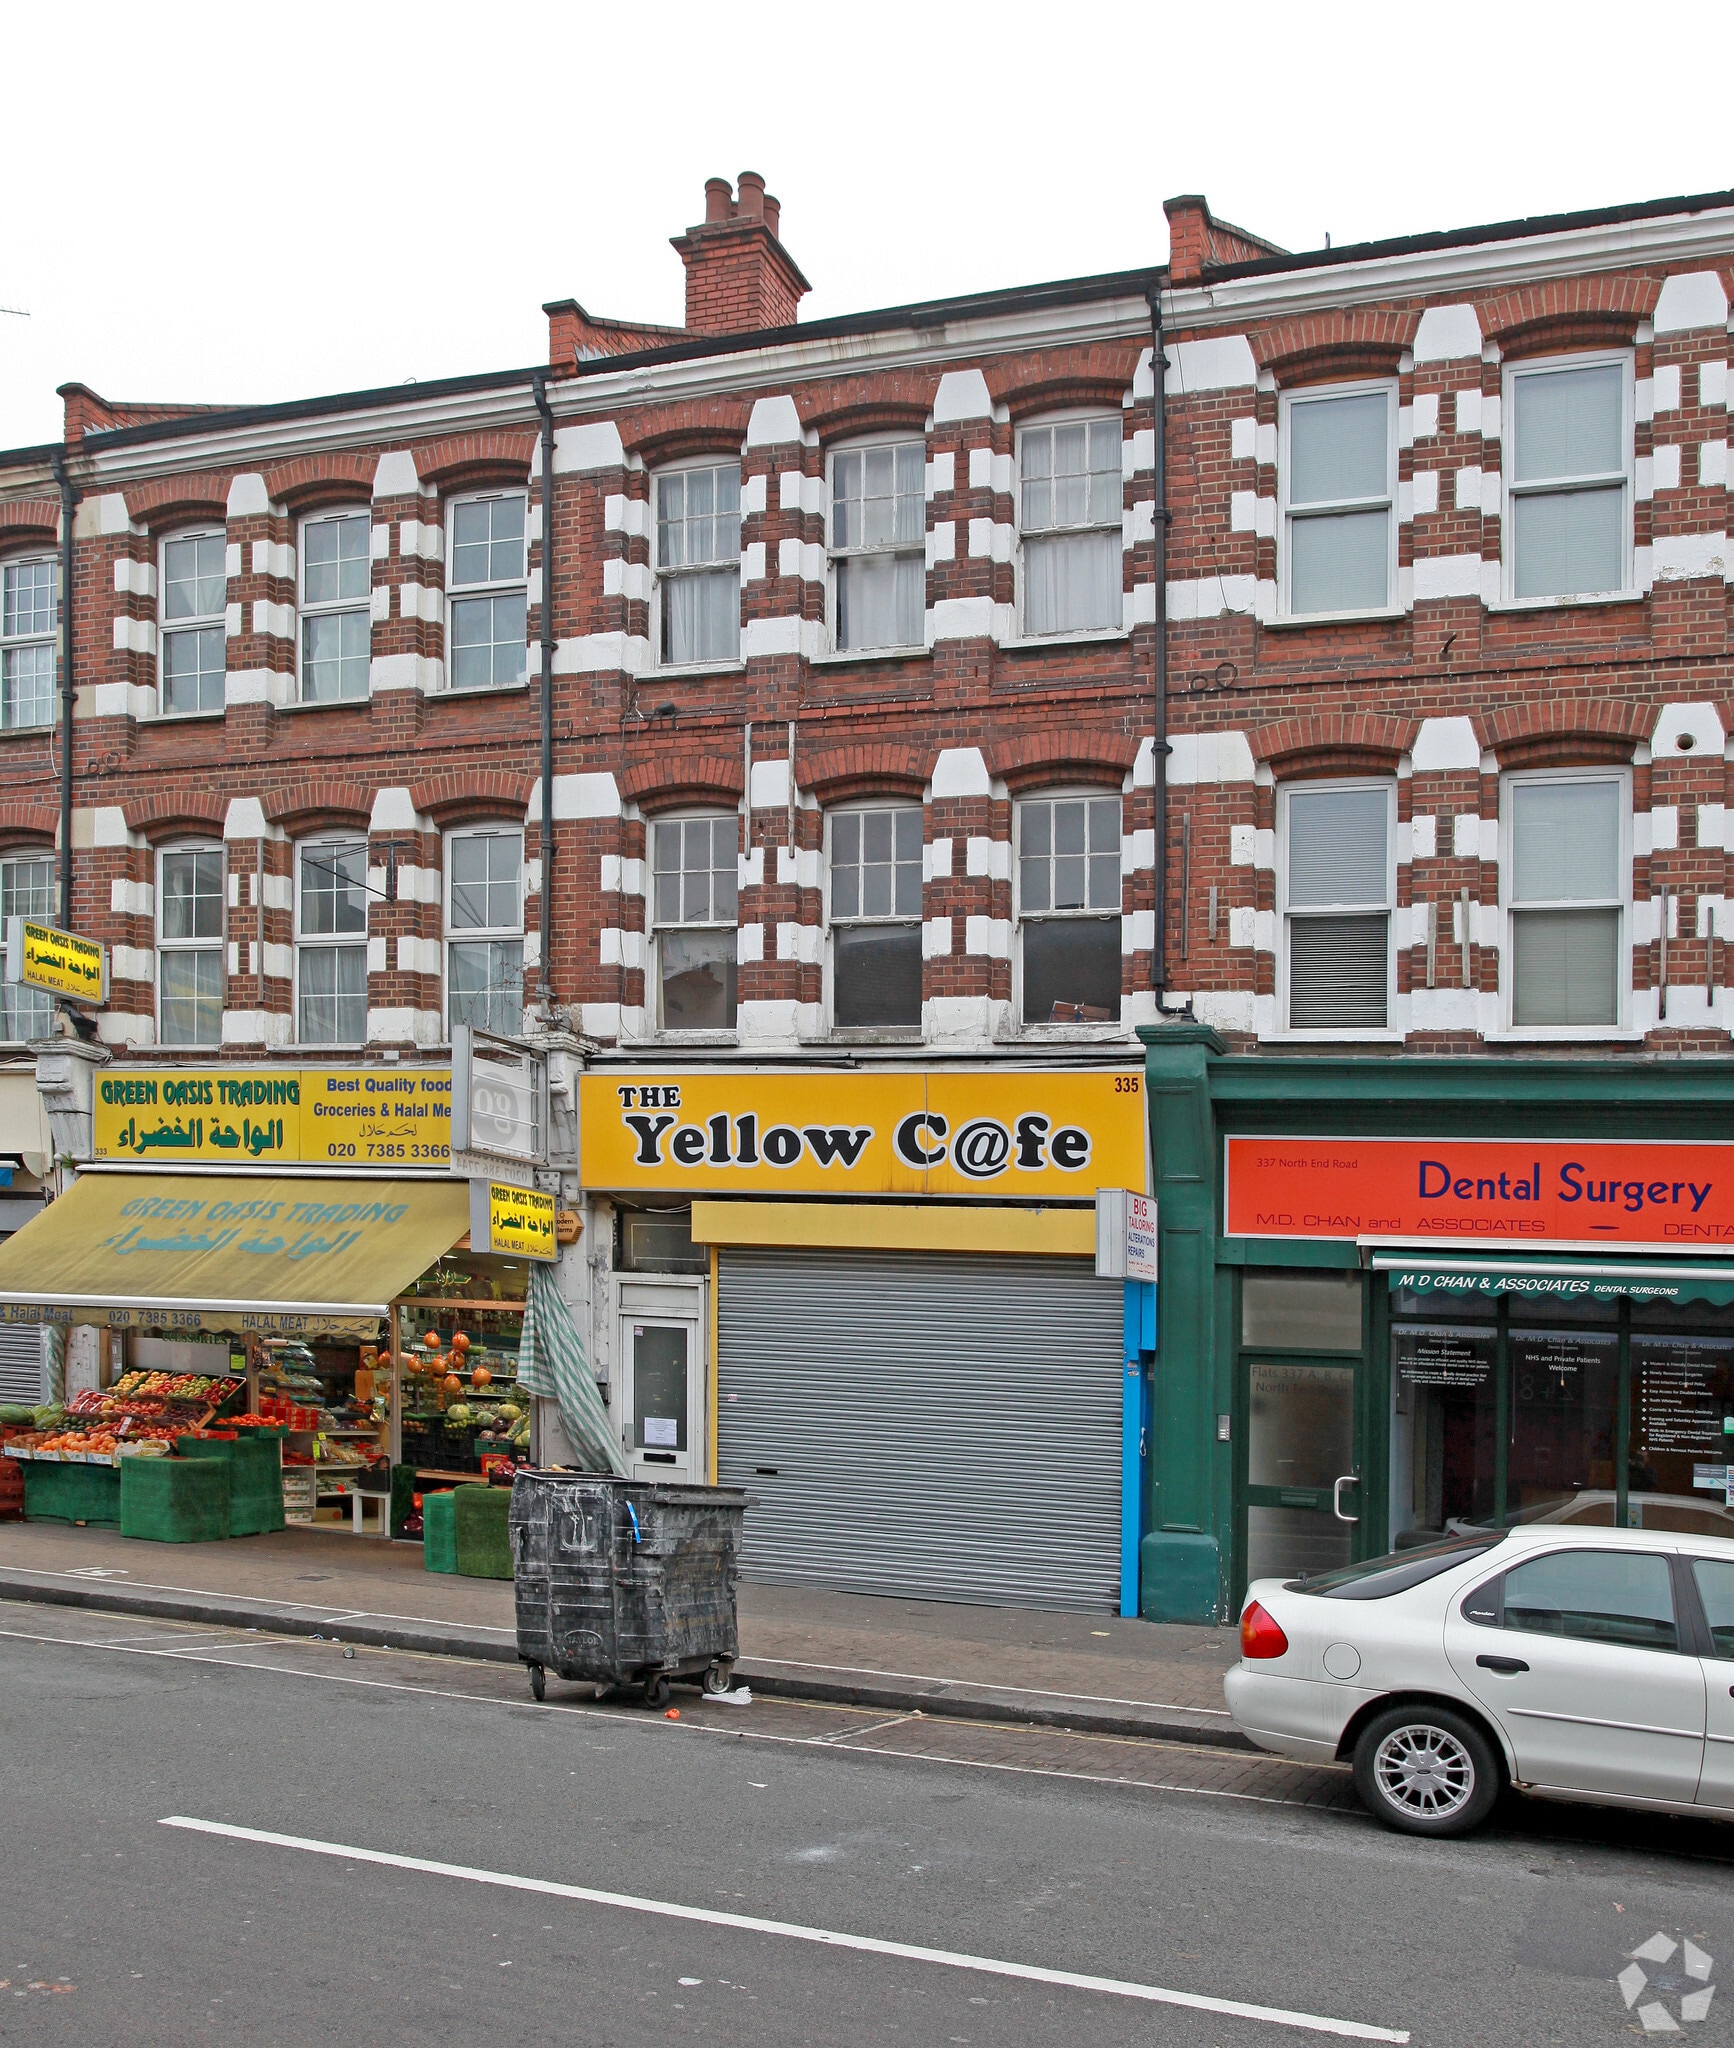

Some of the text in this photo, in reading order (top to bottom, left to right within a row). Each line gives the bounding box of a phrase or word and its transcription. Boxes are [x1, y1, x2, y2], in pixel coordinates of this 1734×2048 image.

[25, 925, 99, 959] GREEN OASIS TRADING
[27, 970, 64, 988] HALAL MEAT
[101, 1080, 300, 1107] GREEN OASIS TRADING
[327, 1078, 452, 1095] Best Quality food
[1114, 1077, 1139, 1094] 335
[618, 1087, 680, 1107] THE
[313, 1103, 376, 1117] Groceries
[381, 1104, 390, 1117] &
[394, 1103, 429, 1117] Halal
[117, 1116, 283, 1156] الواحة الخضراء
[625, 1112, 1090, 1177] Yellow C@fe
[95, 1147, 107, 1155] 333
[327, 1143, 450, 1158] 020 7385 3366
[1257, 1158, 1358, 1169] 337 North End Road
[1419, 1160, 1713, 1213] Dental Surgery
[491, 1186, 553, 1211] GREEN OASIS TRADING
[120, 1196, 410, 1224] GREEN OASIS TRADING
[1133, 1198, 1147, 1217] BIG
[1129, 1216, 1155, 1233] TAILORING
[1256, 1213, 1546, 1232] M.D. CHAN and ASSOCIATES
[97, 1225, 363, 1260] الواحة الخضراء
[494, 1237, 525, 1250] HALAL MEAT
[1128, 1232, 1155, 1248] ALTERATIONS
[1128, 1245, 1145, 1259] REPAIRS
[1399, 1274, 1679, 1296] M D CHAN & ASSOCIATES DENTAL SURGEONS
[10, 1305, 41, 1320] Halal
[43, 1307, 74, 1321] Meat
[109, 1310, 201, 1326] 020 7385 3366
[242, 1314, 309, 1330] HALAL MEAT
[1440, 1349, 1471, 1357] Statement
[1252, 1366, 1277, 1378] Flats
[1548, 1364, 1578, 1372] Welcome
